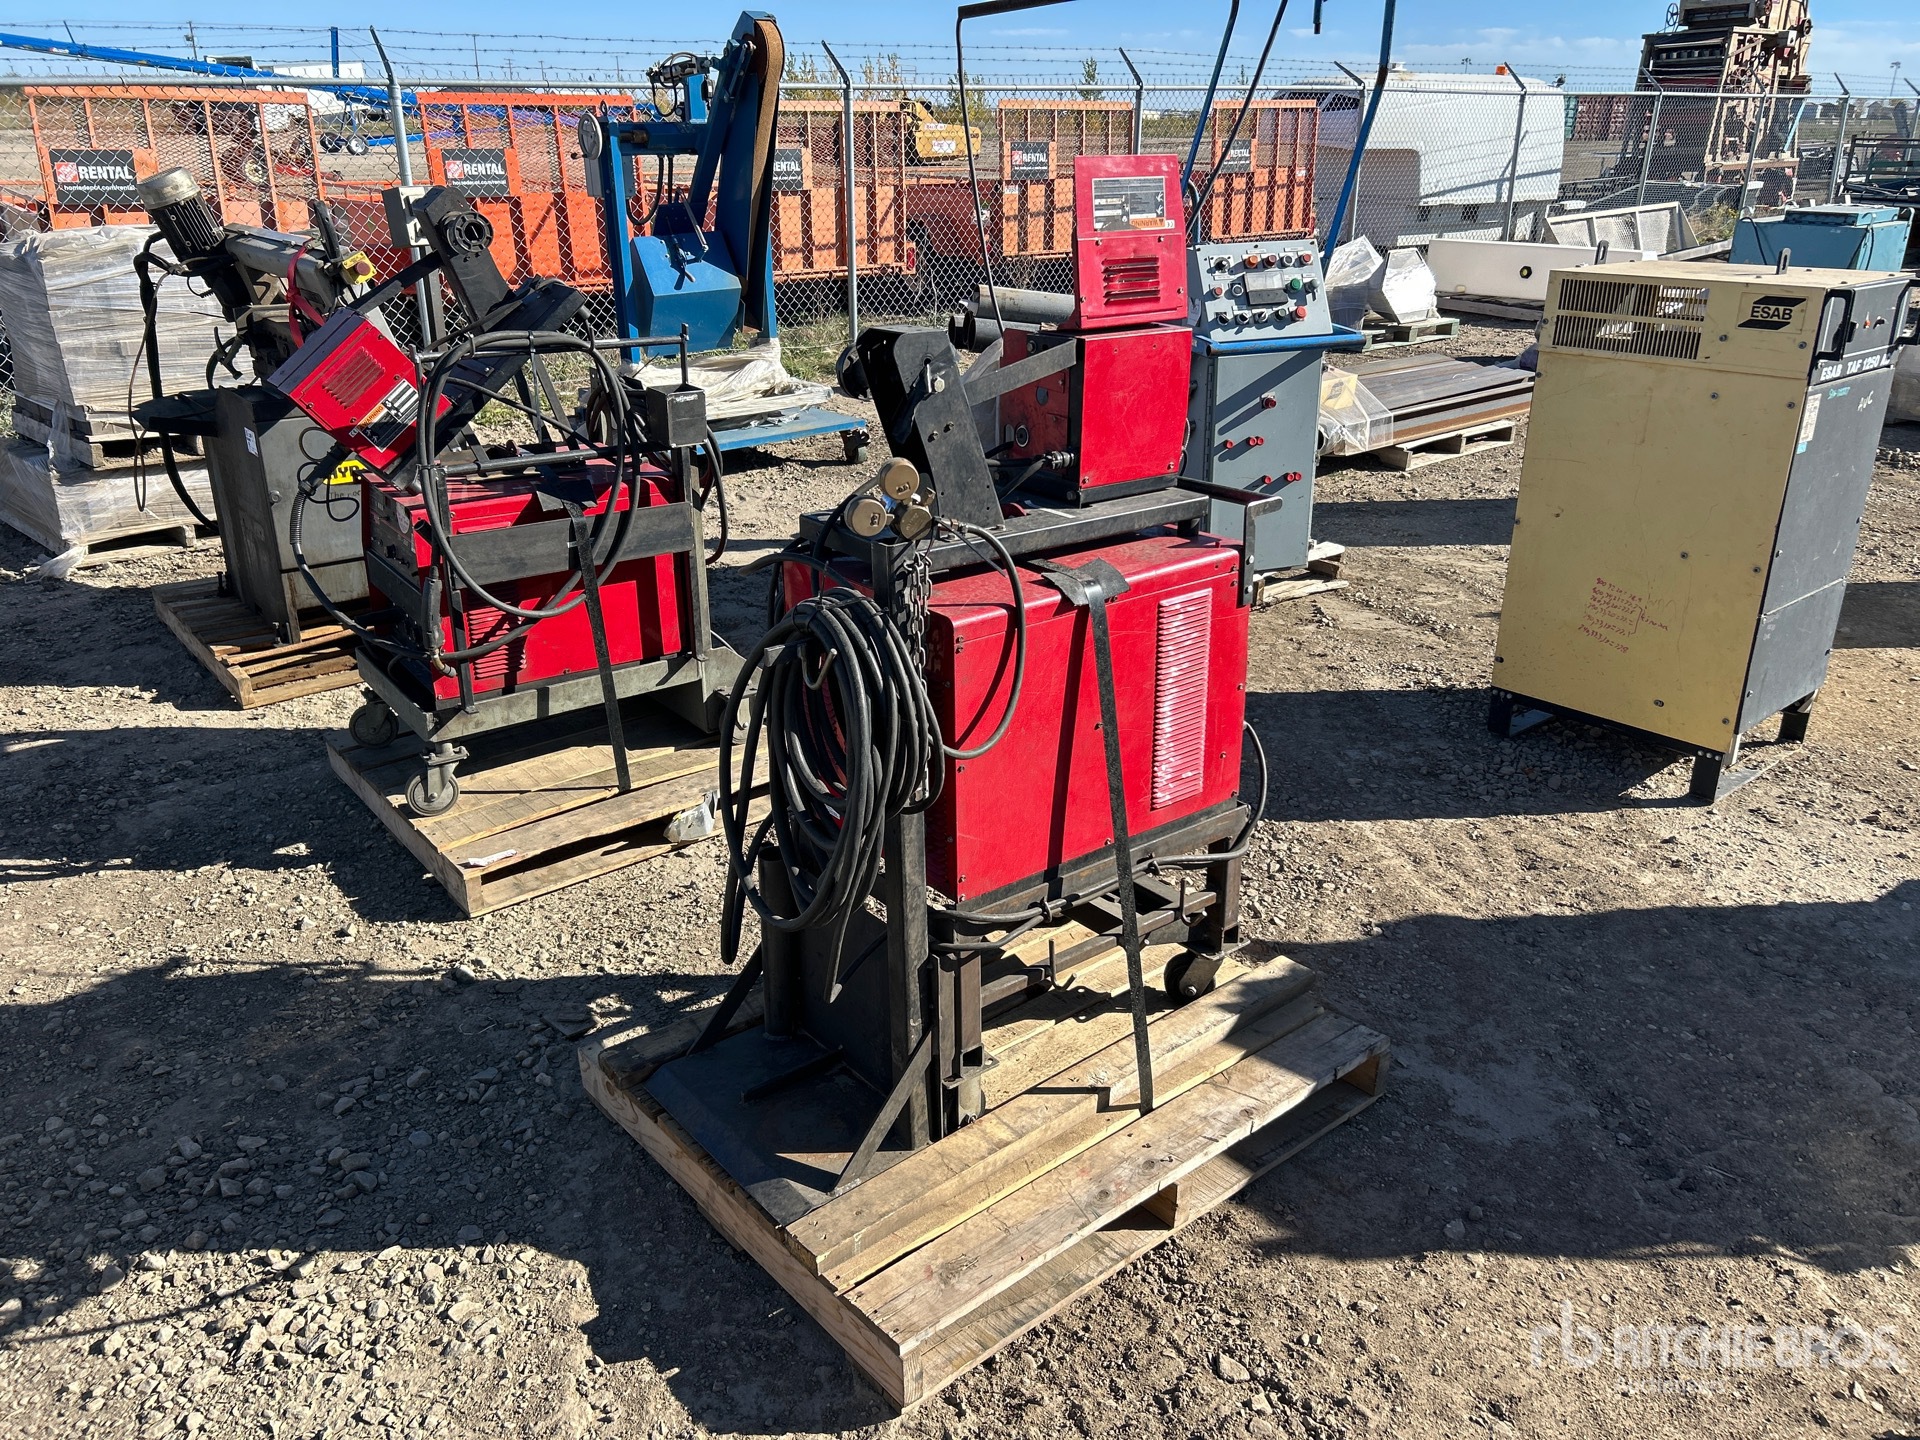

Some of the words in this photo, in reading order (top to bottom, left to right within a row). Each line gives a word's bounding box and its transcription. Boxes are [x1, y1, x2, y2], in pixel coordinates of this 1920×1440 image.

[1022, 153, 1047, 162] RENTAL
[463, 163, 504, 175] RENTAL
[773, 161, 801, 171] ENTAL
[78, 166, 134, 179] RENTAL
[1750, 305, 1793, 320] ESAB
[1820, 364, 1843, 381] ESAB
[1846, 359, 1862, 375] TAF
[1862, 355, 1881, 371] 1250
